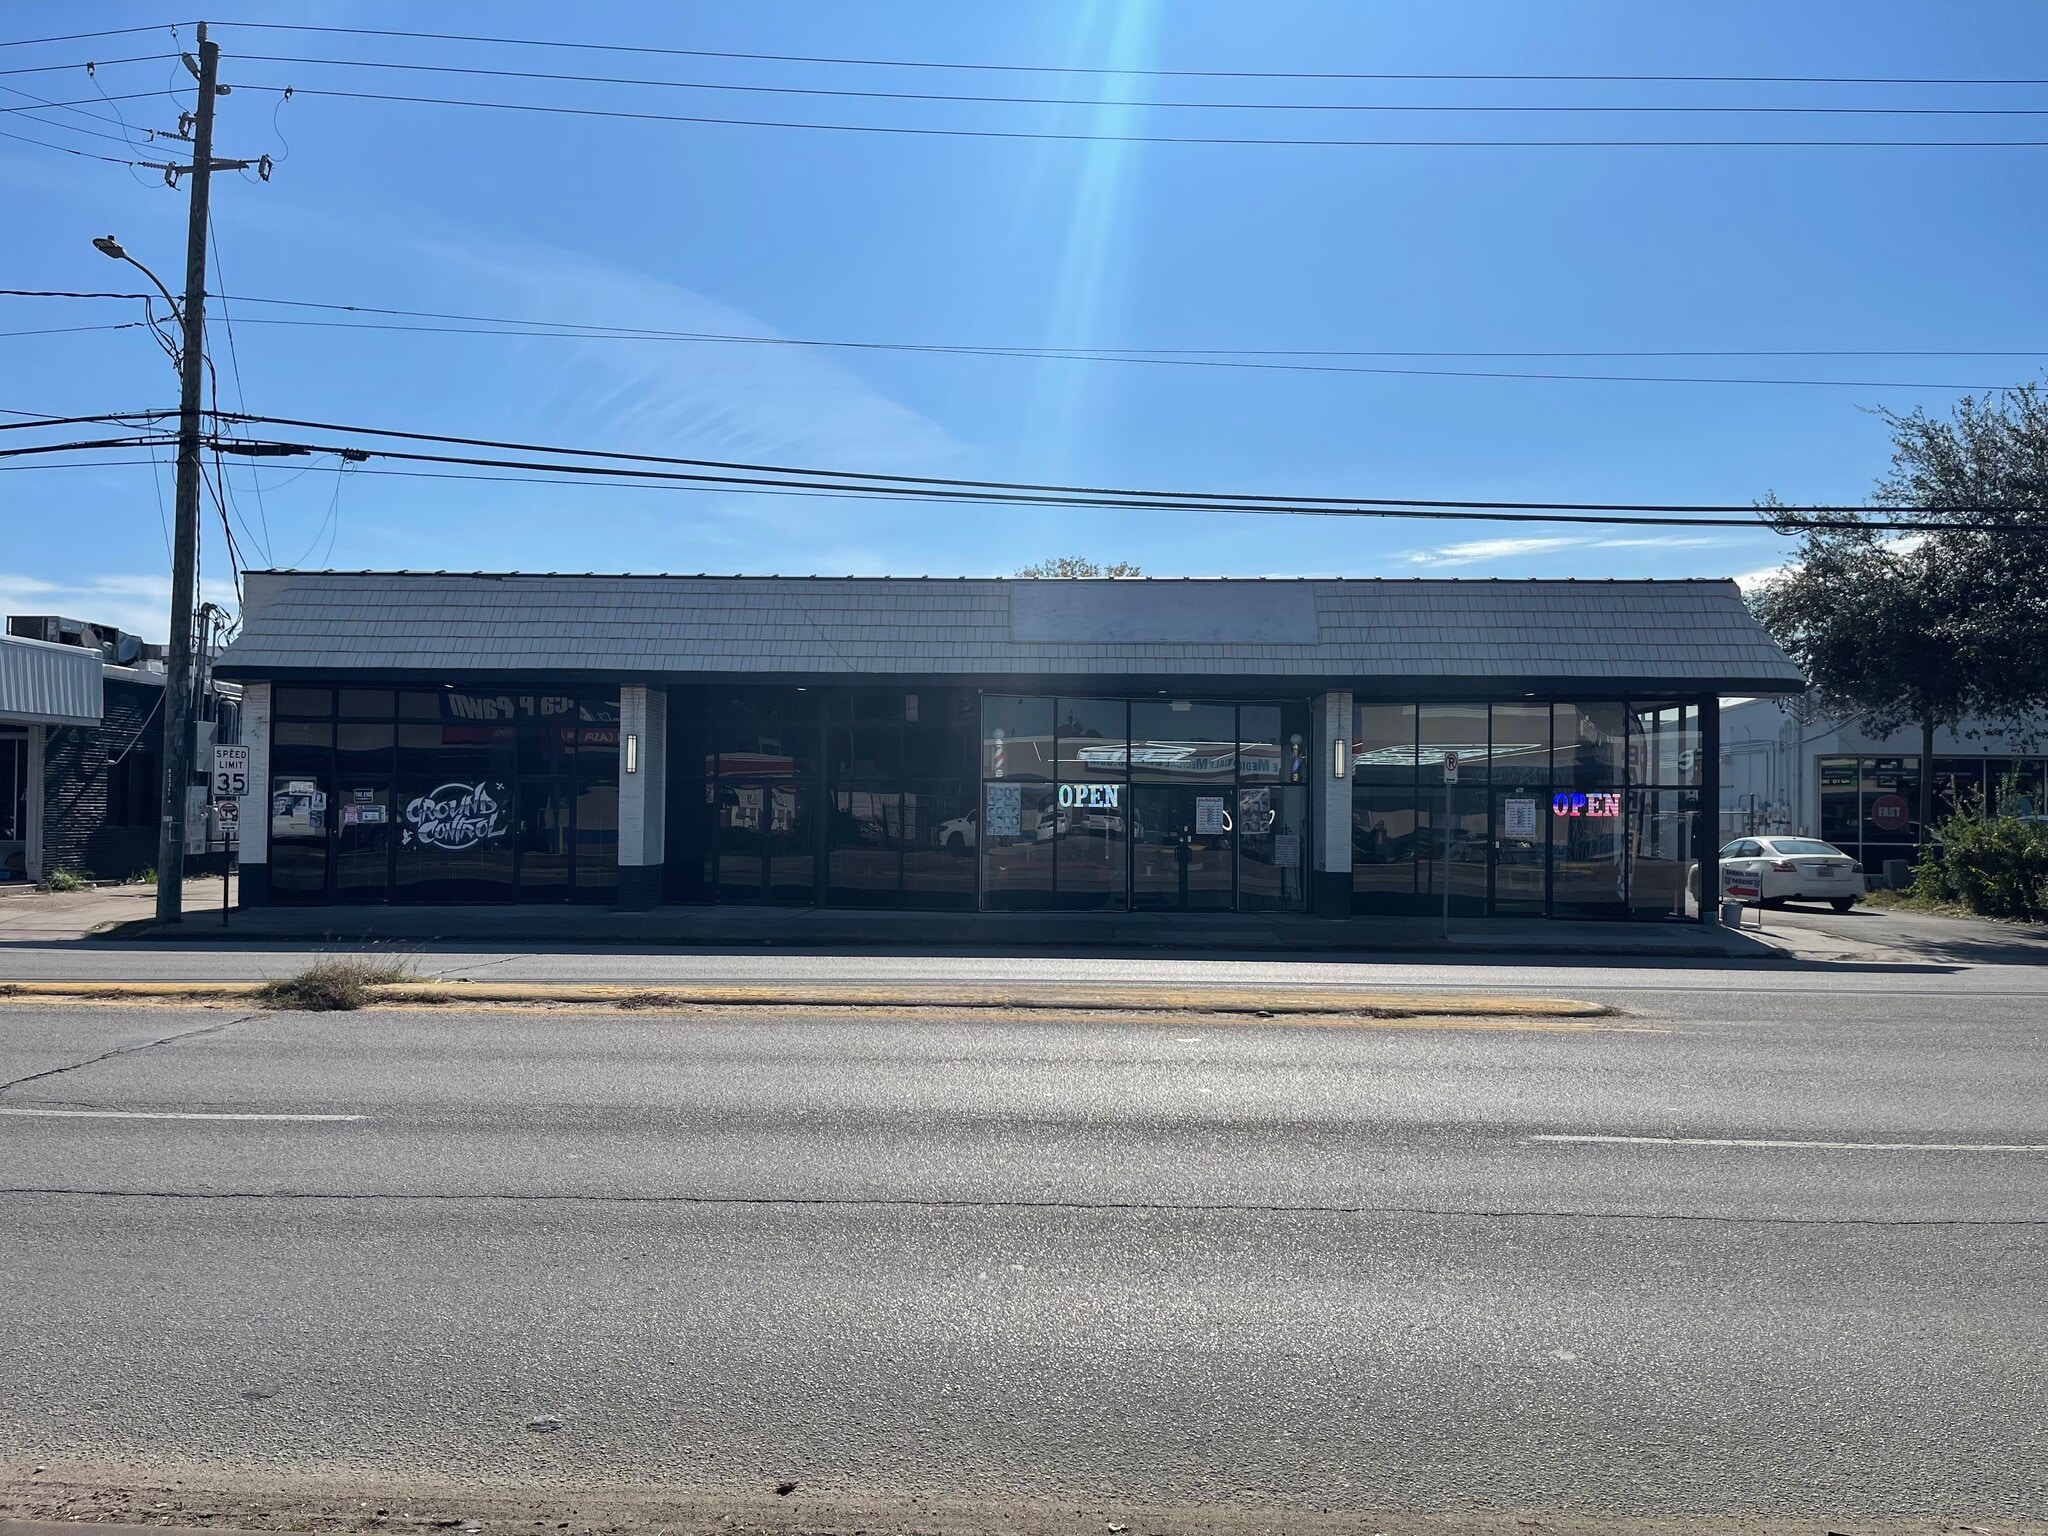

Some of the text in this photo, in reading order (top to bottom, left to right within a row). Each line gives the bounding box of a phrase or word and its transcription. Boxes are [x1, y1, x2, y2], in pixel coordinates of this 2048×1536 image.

[216, 749, 247, 759] SPEED
[219, 761, 244, 769] LIMIT
[217, 772, 245, 791] 35
[405, 781, 498, 827] GROUND
[1058, 784, 1119, 808] OPEN
[1552, 793, 1621, 817] OPEN
[1878, 807, 1901, 817] FAST
[417, 809, 509, 844] CONTROL
